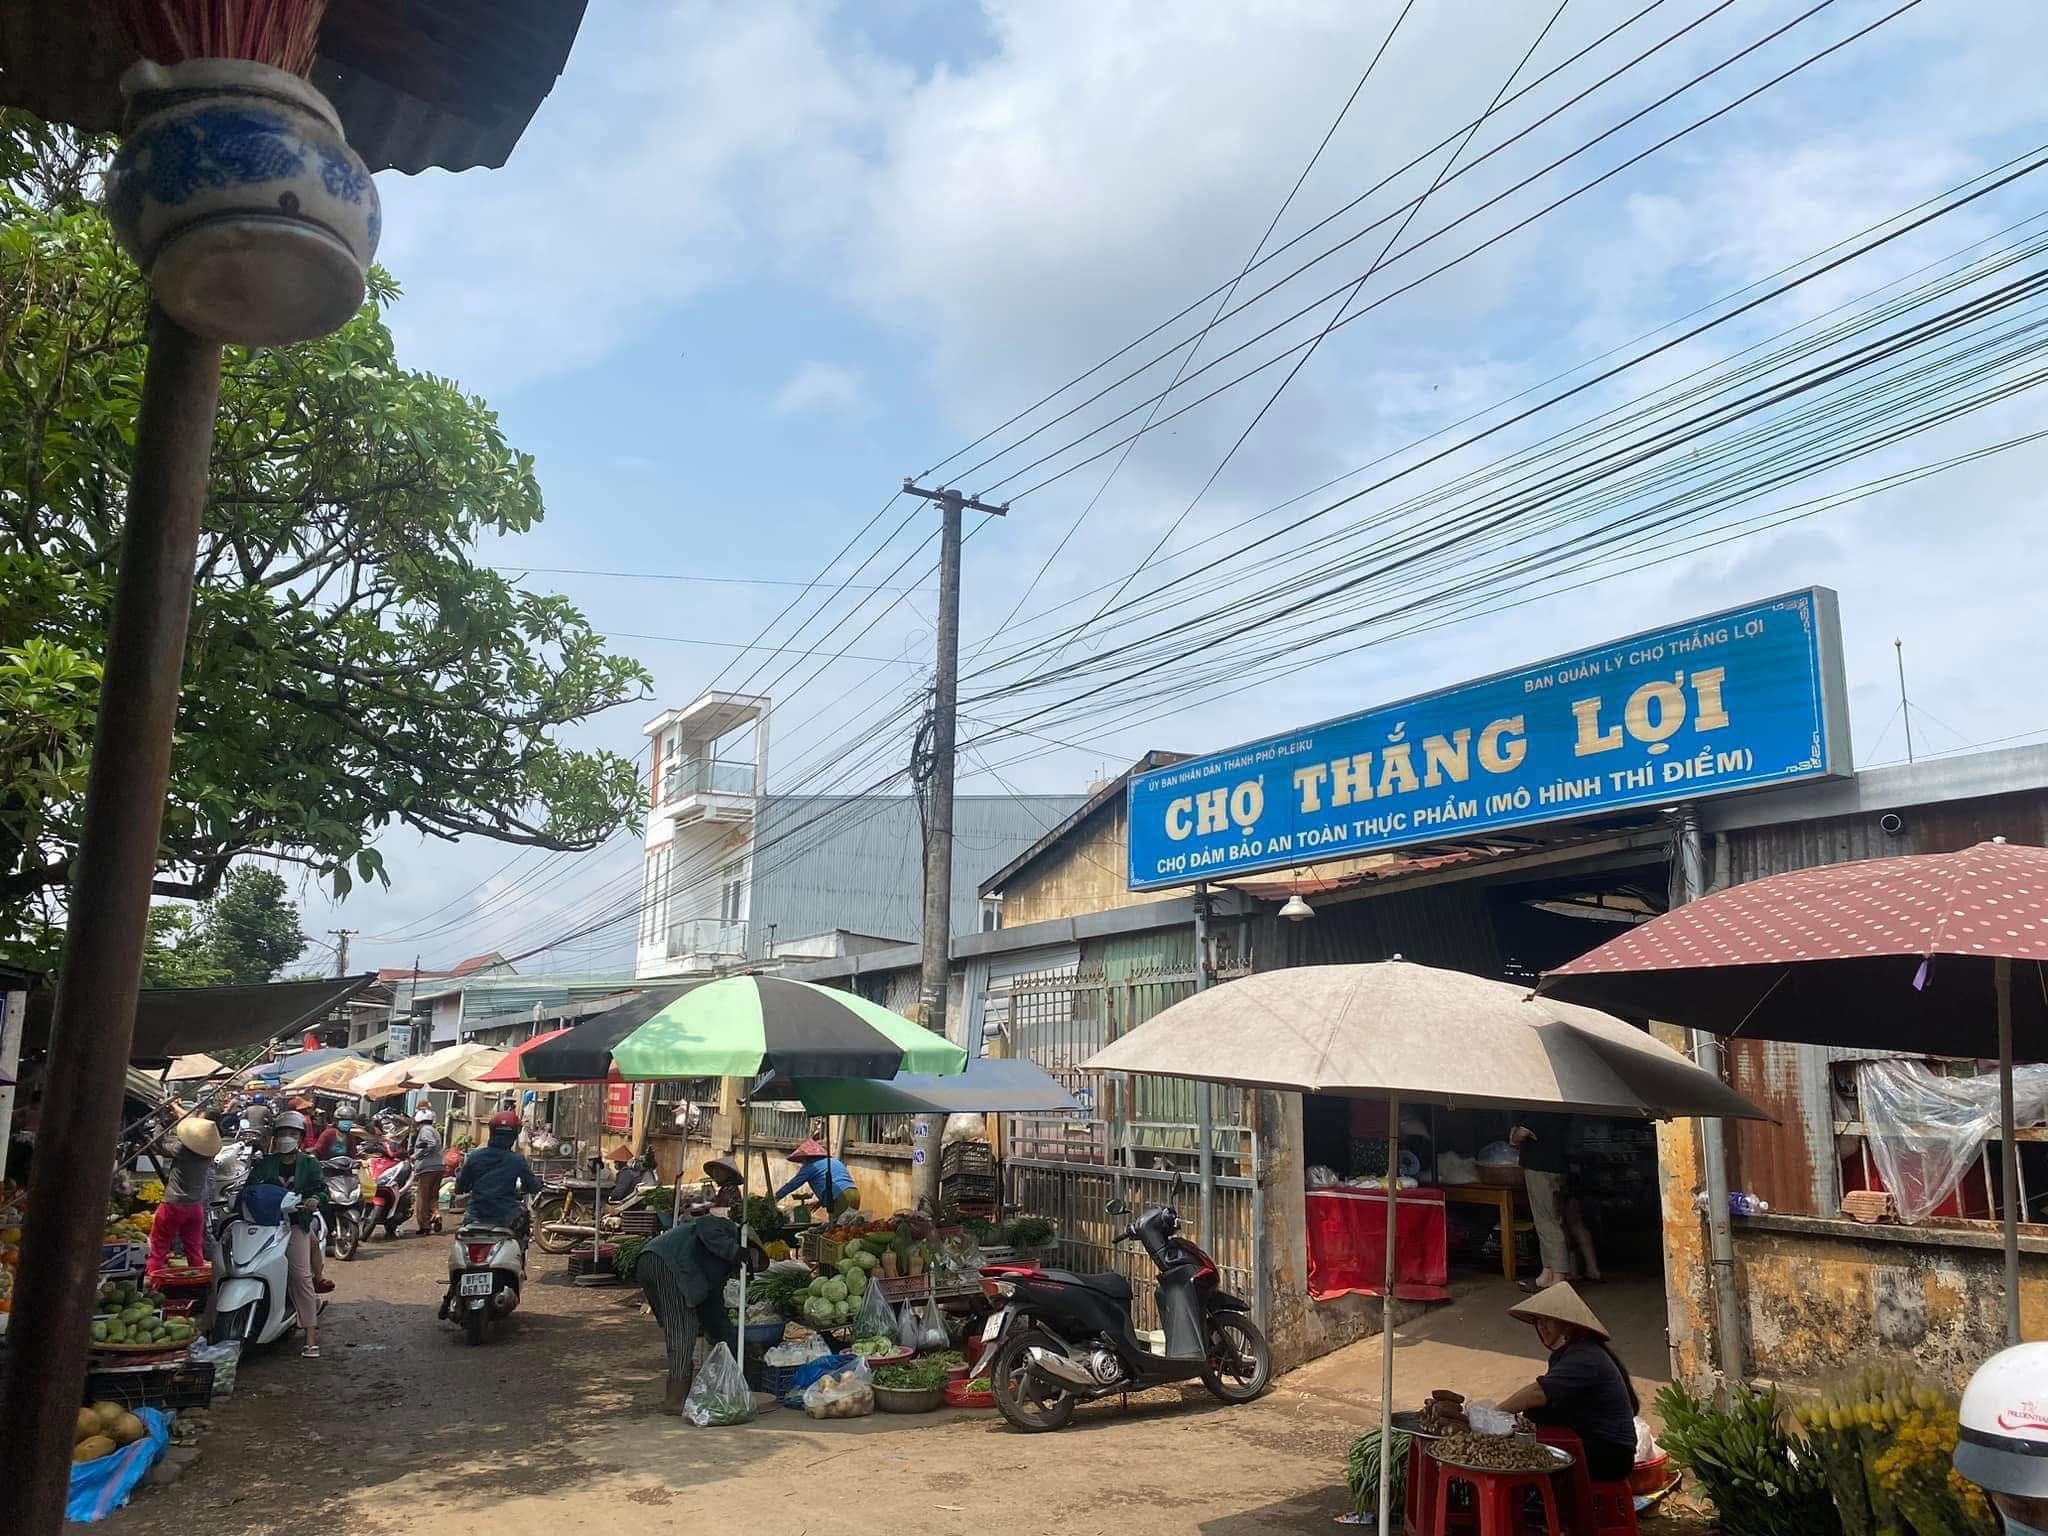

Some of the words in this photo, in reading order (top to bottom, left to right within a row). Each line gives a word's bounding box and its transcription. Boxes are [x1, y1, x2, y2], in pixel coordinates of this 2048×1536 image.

[1524, 675, 1554, 693] BAN
[1558, 661, 1600, 685] QUẢN
[1604, 655, 1624, 672] LÝ
[1629, 646, 1664, 666] CHỢ
[1668, 630, 1729, 655] THẮNG
[1734, 619, 1764, 641] LỢI
[1161, 776, 1178, 789] BAN
[1179, 767, 1201, 784] NHÂN
[1203, 763, 1222, 777] DÂN
[1223, 754, 1254, 771] THÀNH
[1255, 746, 1275, 763] PHỐ
[1278, 739, 1313, 757] PLEIKU
[1165, 774, 1264, 841] CHỢ
[1294, 714, 1527, 814] THẮNG
[1571, 666, 1730, 757] LỢI
[1156, 853, 1186, 874] CHỢ
[1190, 845, 1225, 868] ĐẢM
[1229, 838, 1263, 860] BẢO
[1267, 834, 1292, 853] AN
[1296, 823, 1347, 848] TOÀN
[1353, 812, 1407, 837] THỰC
[1413, 794, 1477, 827] PHẨM
[1485, 786, 1531, 816] (MÔ
[1538, 778, 1600, 805] HÌNH
[1609, 761, 1654, 792] THÍ
[1662, 745, 1753, 783] ĐIỂM)
